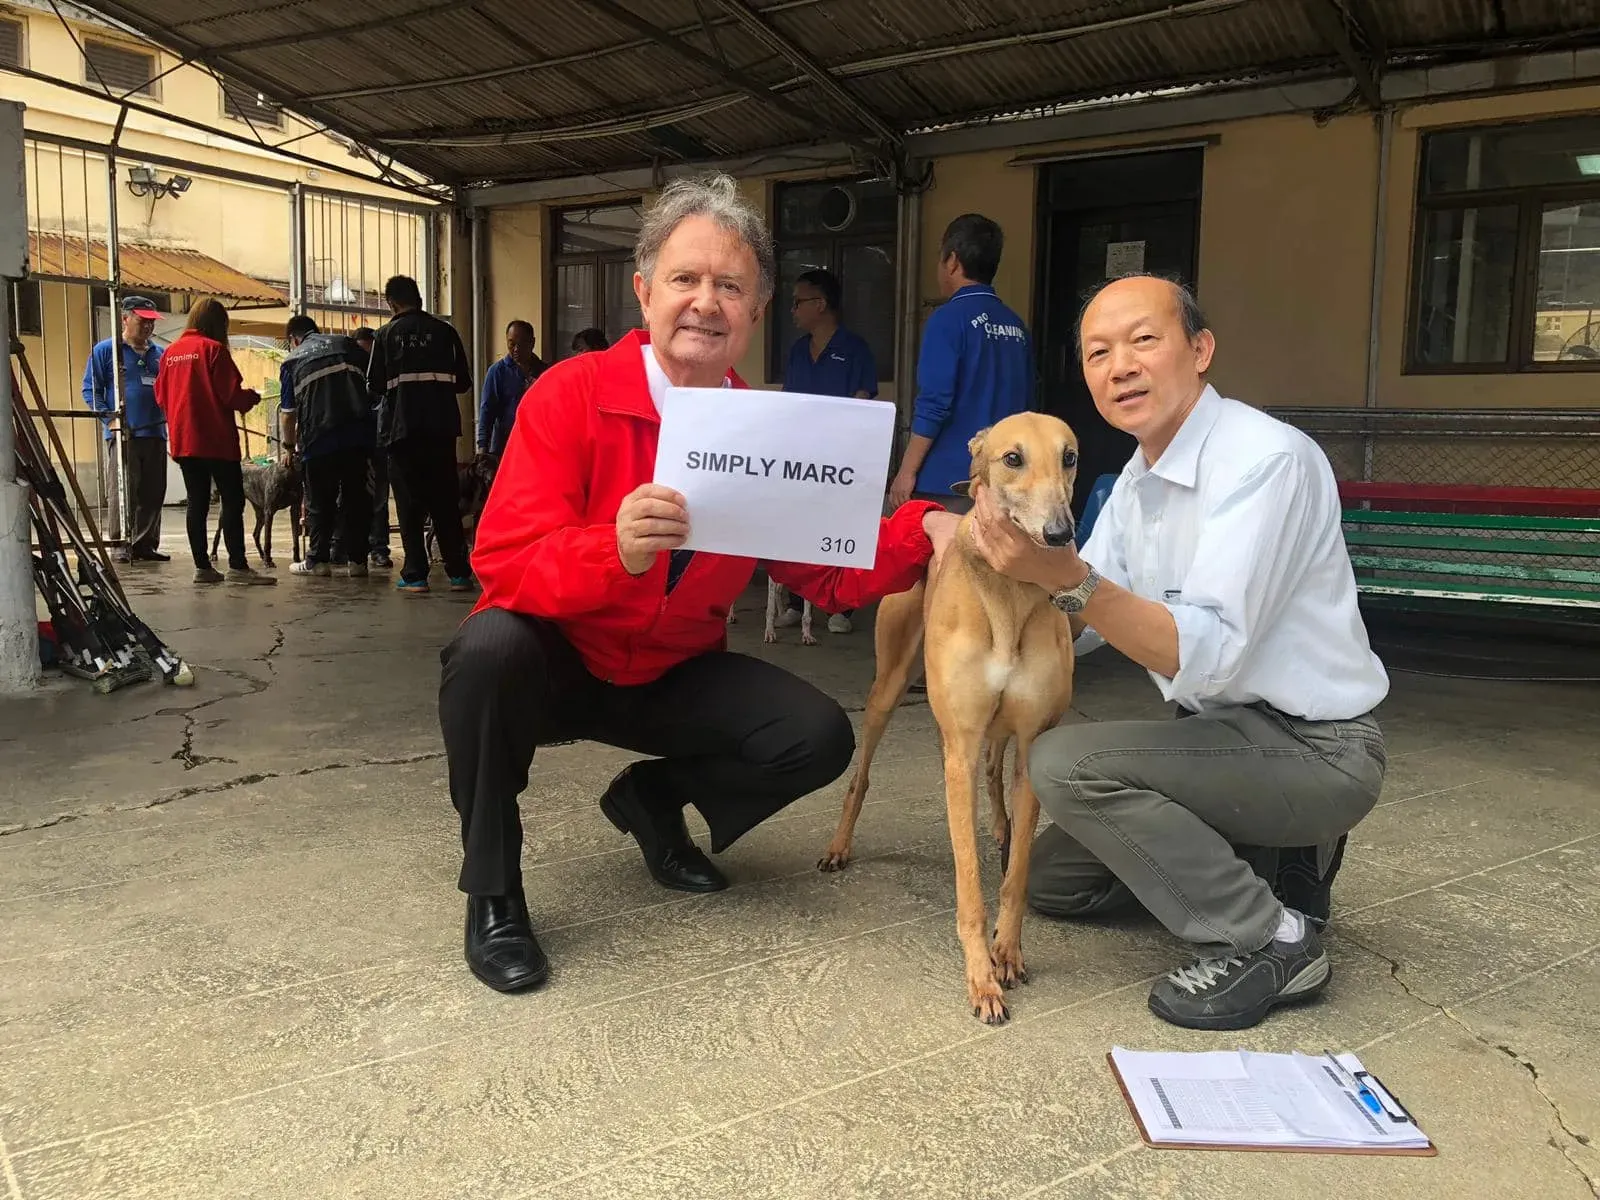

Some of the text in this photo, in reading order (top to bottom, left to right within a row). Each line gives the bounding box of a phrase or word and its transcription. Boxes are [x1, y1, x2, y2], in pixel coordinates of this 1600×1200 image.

[971, 312, 988, 328] PRO
[173, 353, 199, 361] anima
[686, 451, 854, 486] SIMPLY MARC
[821, 536, 856, 555] 310
